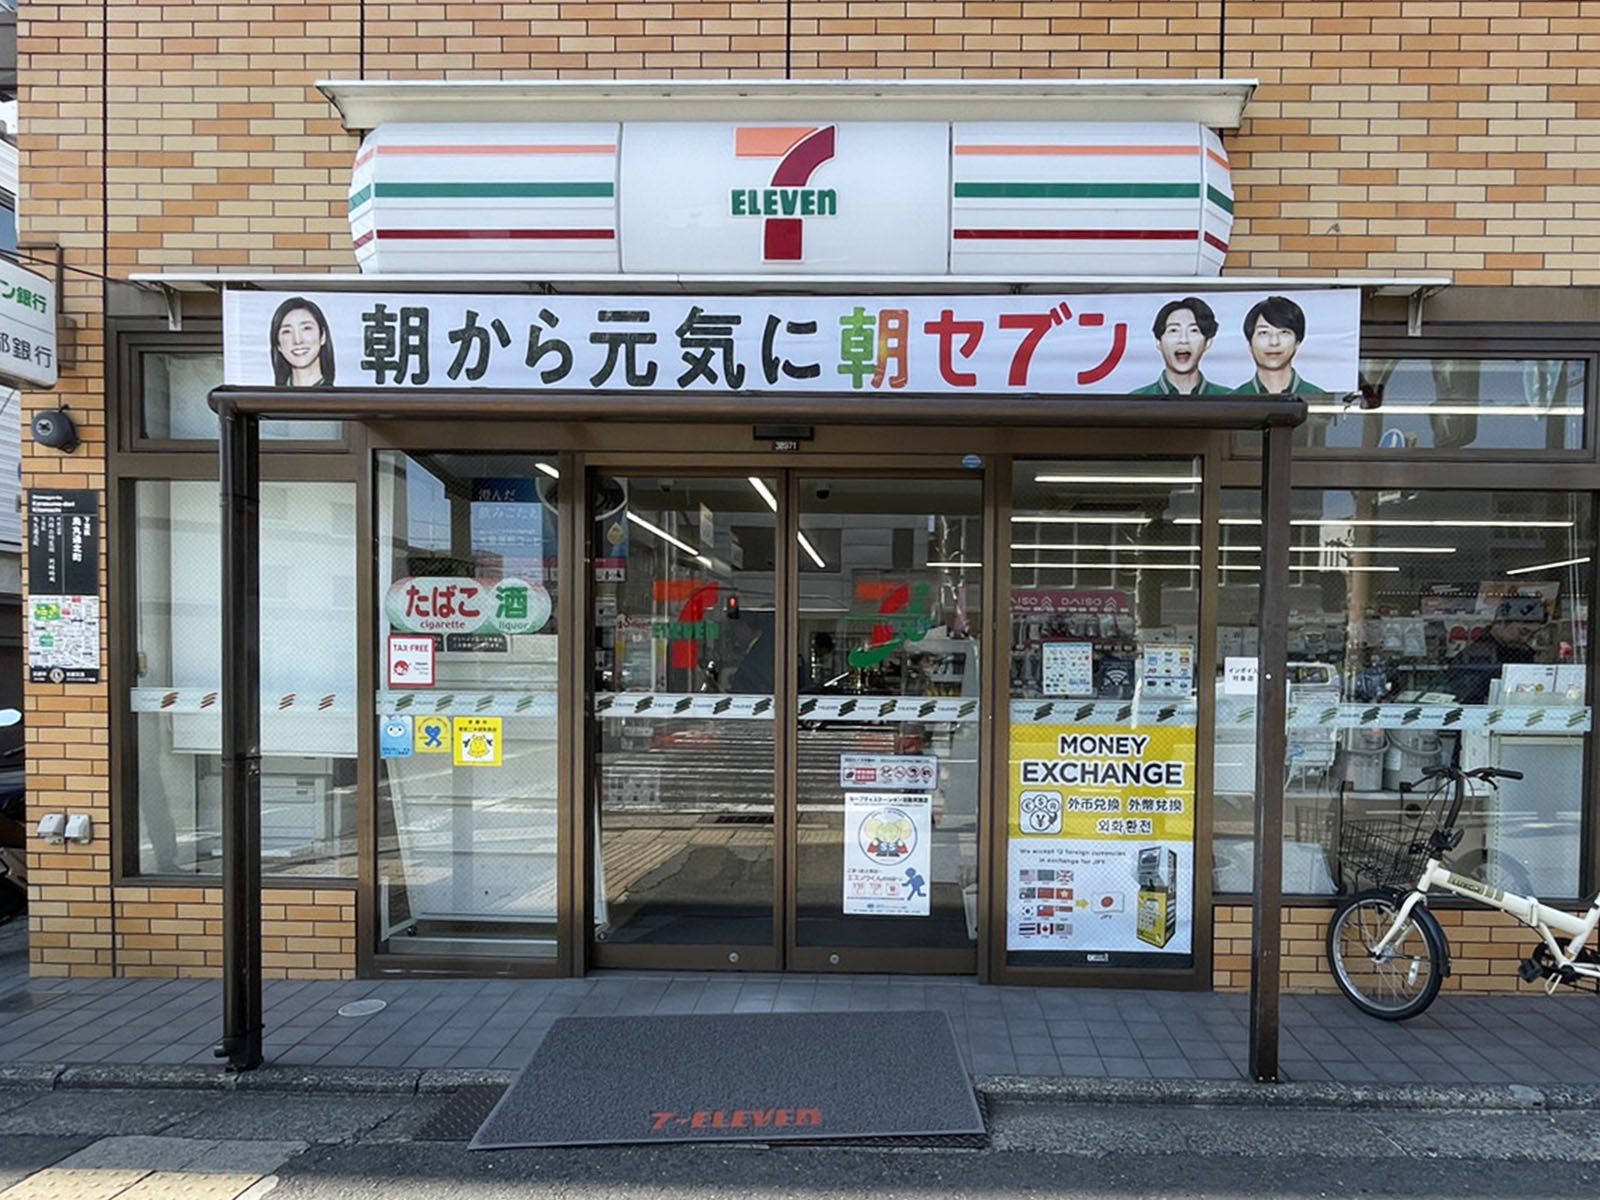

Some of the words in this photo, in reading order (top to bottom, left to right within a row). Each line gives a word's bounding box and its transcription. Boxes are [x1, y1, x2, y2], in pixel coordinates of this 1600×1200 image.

[736, 124, 835, 260] 7
[361, 301, 1128, 389] 朝から元気に朝セブン
[406, 585, 480, 619] たばこ
[495, 586, 528, 619] 酒
[420, 620, 466, 631] cigarette
[393, 644, 408, 652] TAX
[410, 644, 429, 652] FREE
[1060, 736, 1148, 755] MONEY
[1022, 762, 1182, 784] EXCHANGE
